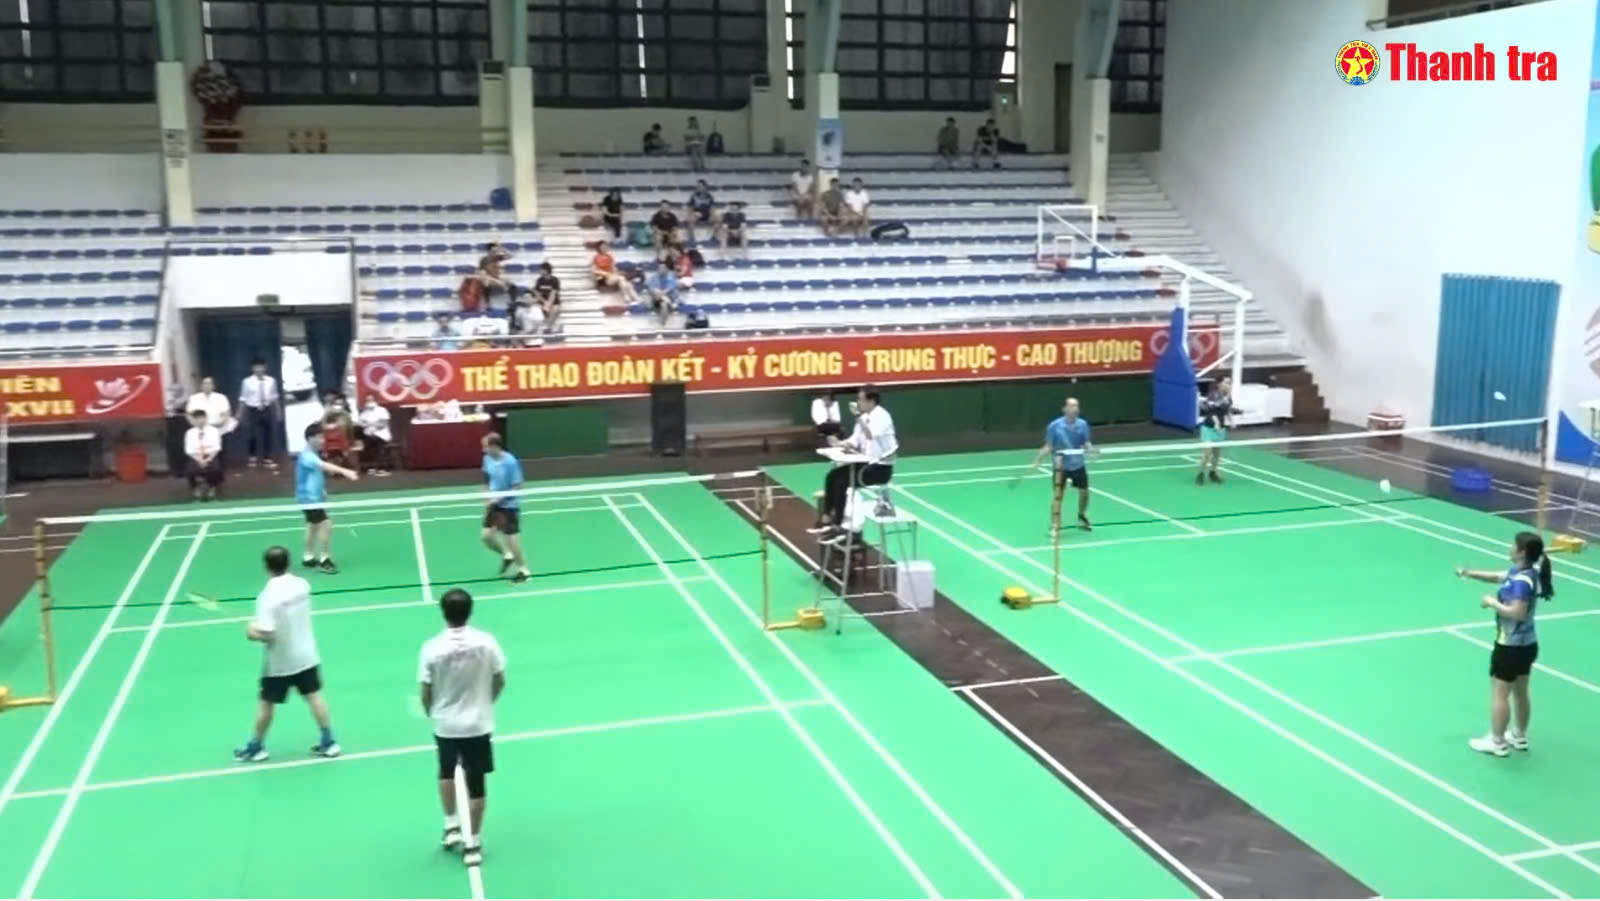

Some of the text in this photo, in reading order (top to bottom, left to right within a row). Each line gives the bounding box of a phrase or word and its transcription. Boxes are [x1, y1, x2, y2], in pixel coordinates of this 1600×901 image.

[460, 355, 510, 392] THỂ
[515, 362, 580, 390] THAO
[587, 355, 655, 387] ĐOÀN
[661, 350, 705, 382] KẾT
[727, 347, 758, 380] KỶ
[764, 350, 843, 377] CƯƠNG
[864, 347, 937, 374] TRUNG
[941, 343, 997, 375] THỰC
[1016, 342, 1058, 367] CAO
[1063, 339, 1144, 369] THƯỢNG
[0, 375, 61, 393] IÊN
[5, 400, 76, 417] XVII
